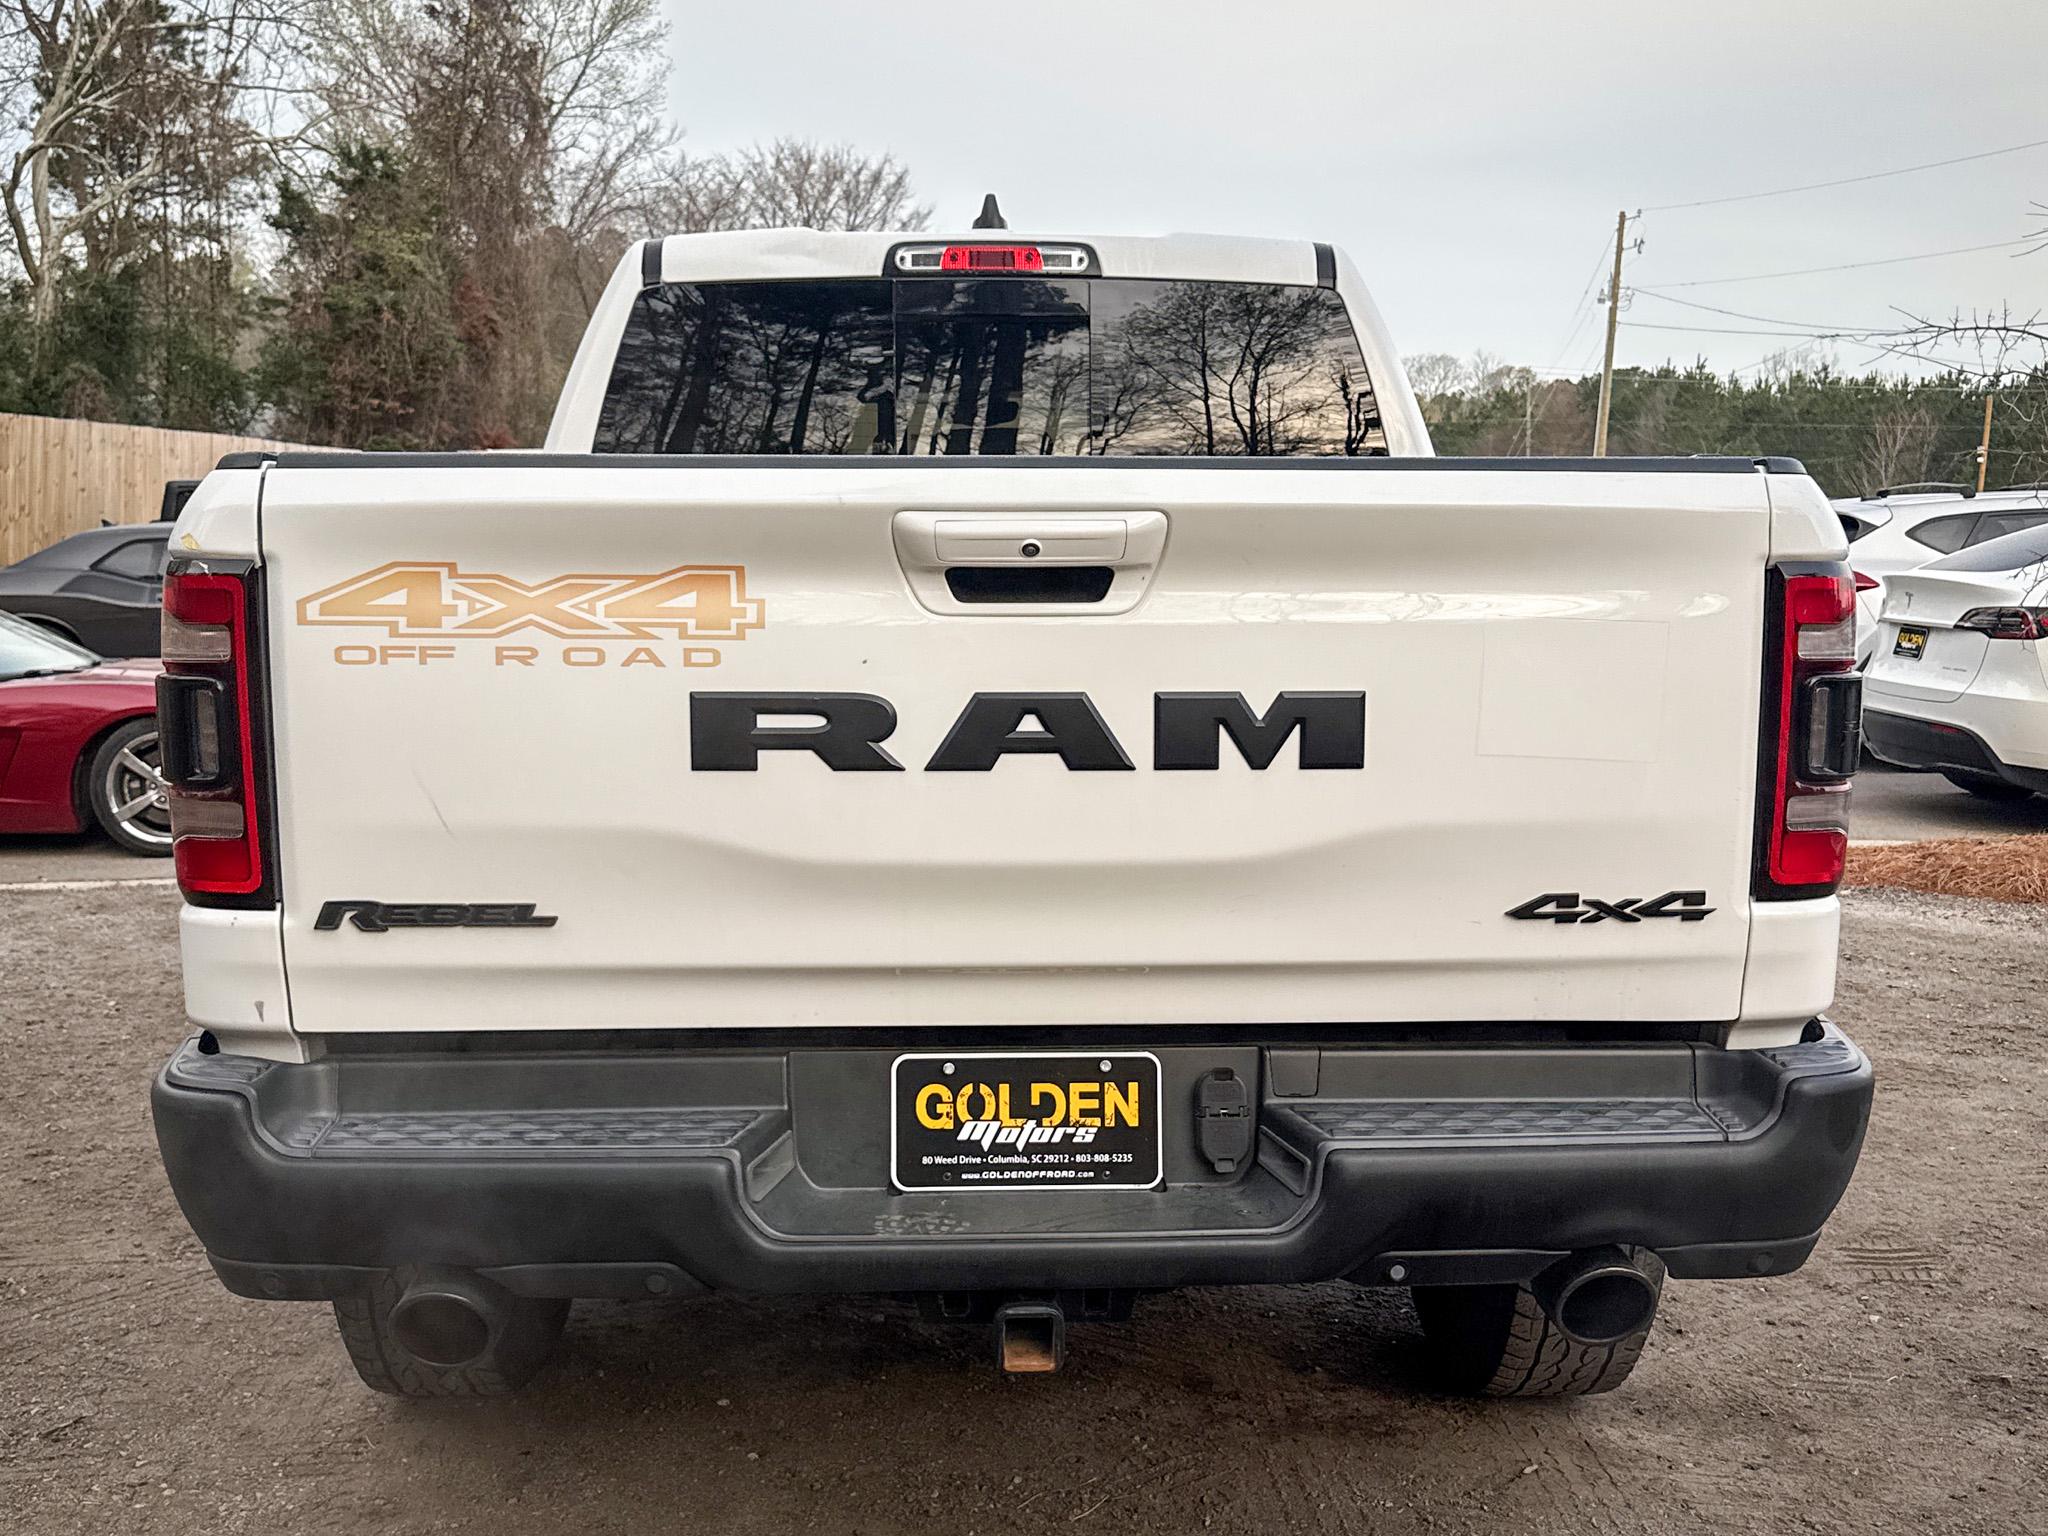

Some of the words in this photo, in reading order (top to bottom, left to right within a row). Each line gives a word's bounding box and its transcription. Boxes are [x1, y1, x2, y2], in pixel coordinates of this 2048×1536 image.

[334, 645, 456, 665] OFF
[495, 646, 722, 667] ROAD
[690, 691, 1365, 771] RAM
[314, 900, 558, 931] REBEL
[915, 1082, 1139, 1129] GOLDEN
[922, 1155, 933, 1165] 80
[934, 1155, 958, 1165] Weed
[959, 1155, 982, 1164] Drive
[988, 1154, 1030, 1165] Columbia,
[1031, 1154, 1042, 1163] SC
[1044, 1154, 1069, 1163] 29212
[1075, 1153, 1133, 1163] 803-808-5235
